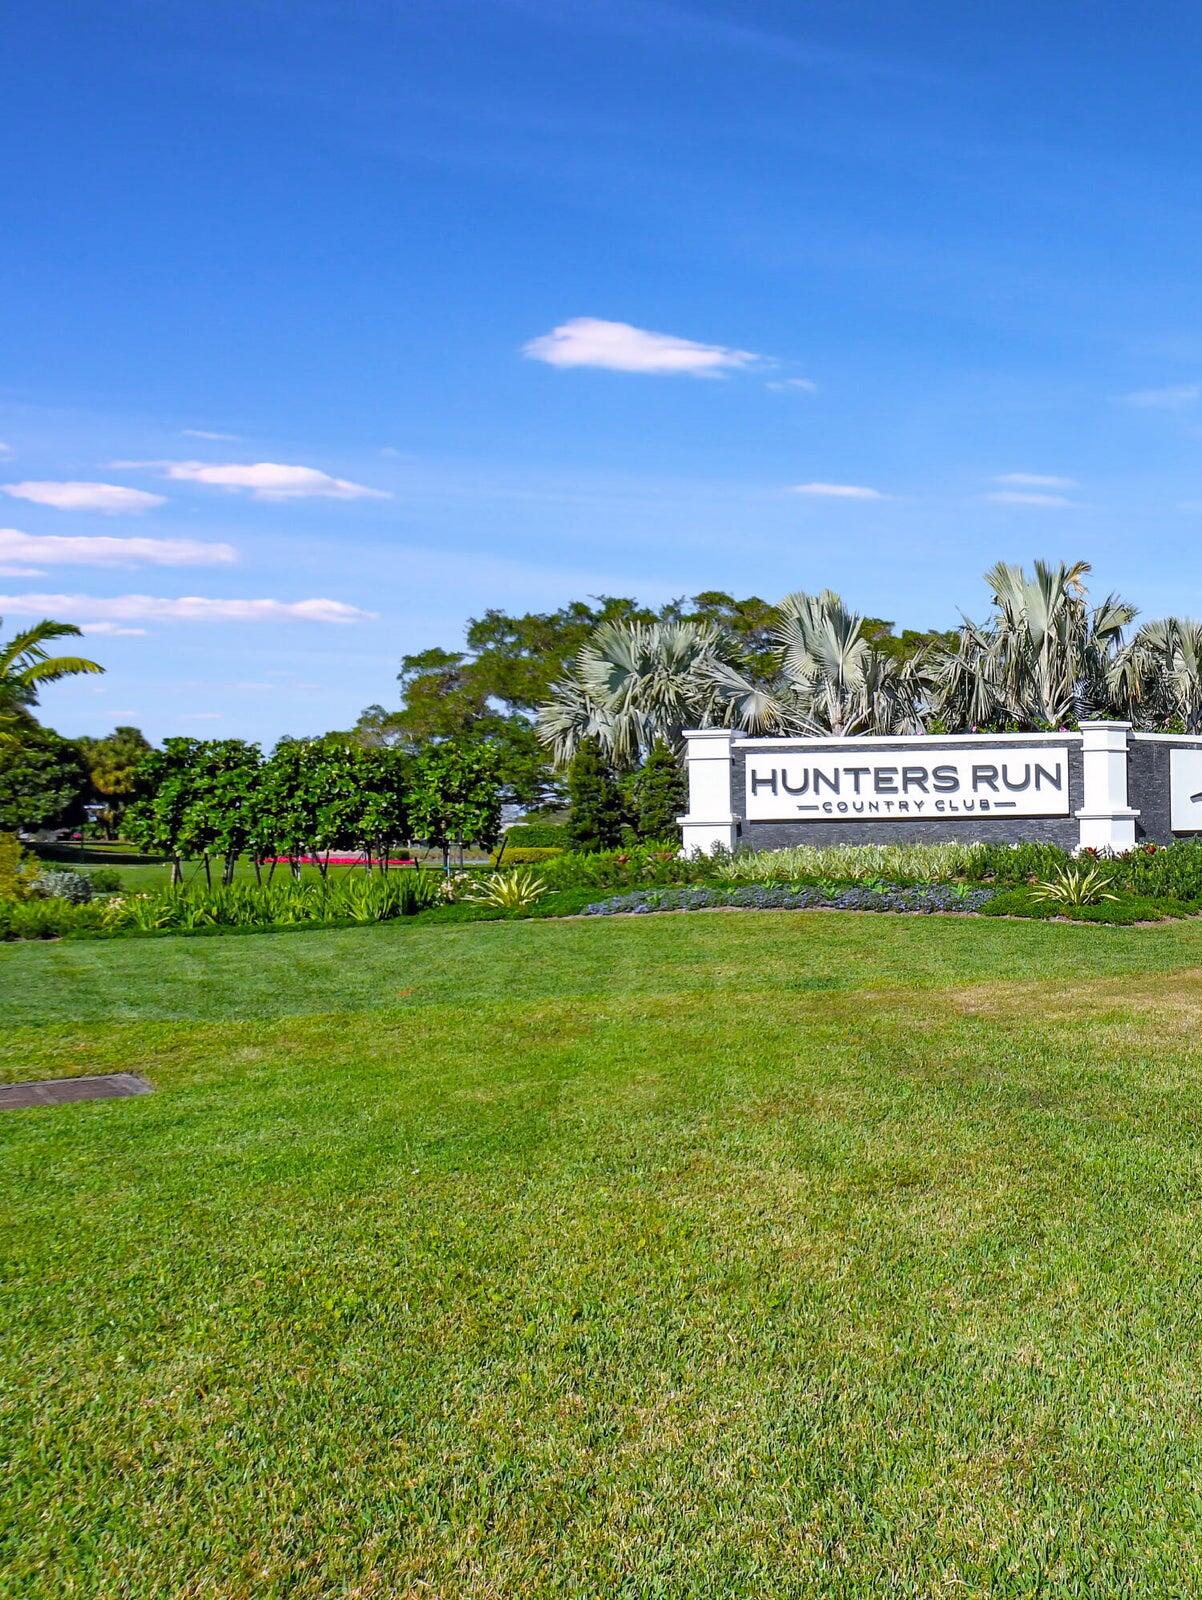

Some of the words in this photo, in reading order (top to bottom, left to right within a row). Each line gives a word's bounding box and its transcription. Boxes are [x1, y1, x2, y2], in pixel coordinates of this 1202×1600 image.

[751, 765, 960, 795] HUNTERS
[971, 763, 1062, 793] RUN
[822, 800, 925, 814] COUNTRY
[935, 799, 990, 812] CLUB
